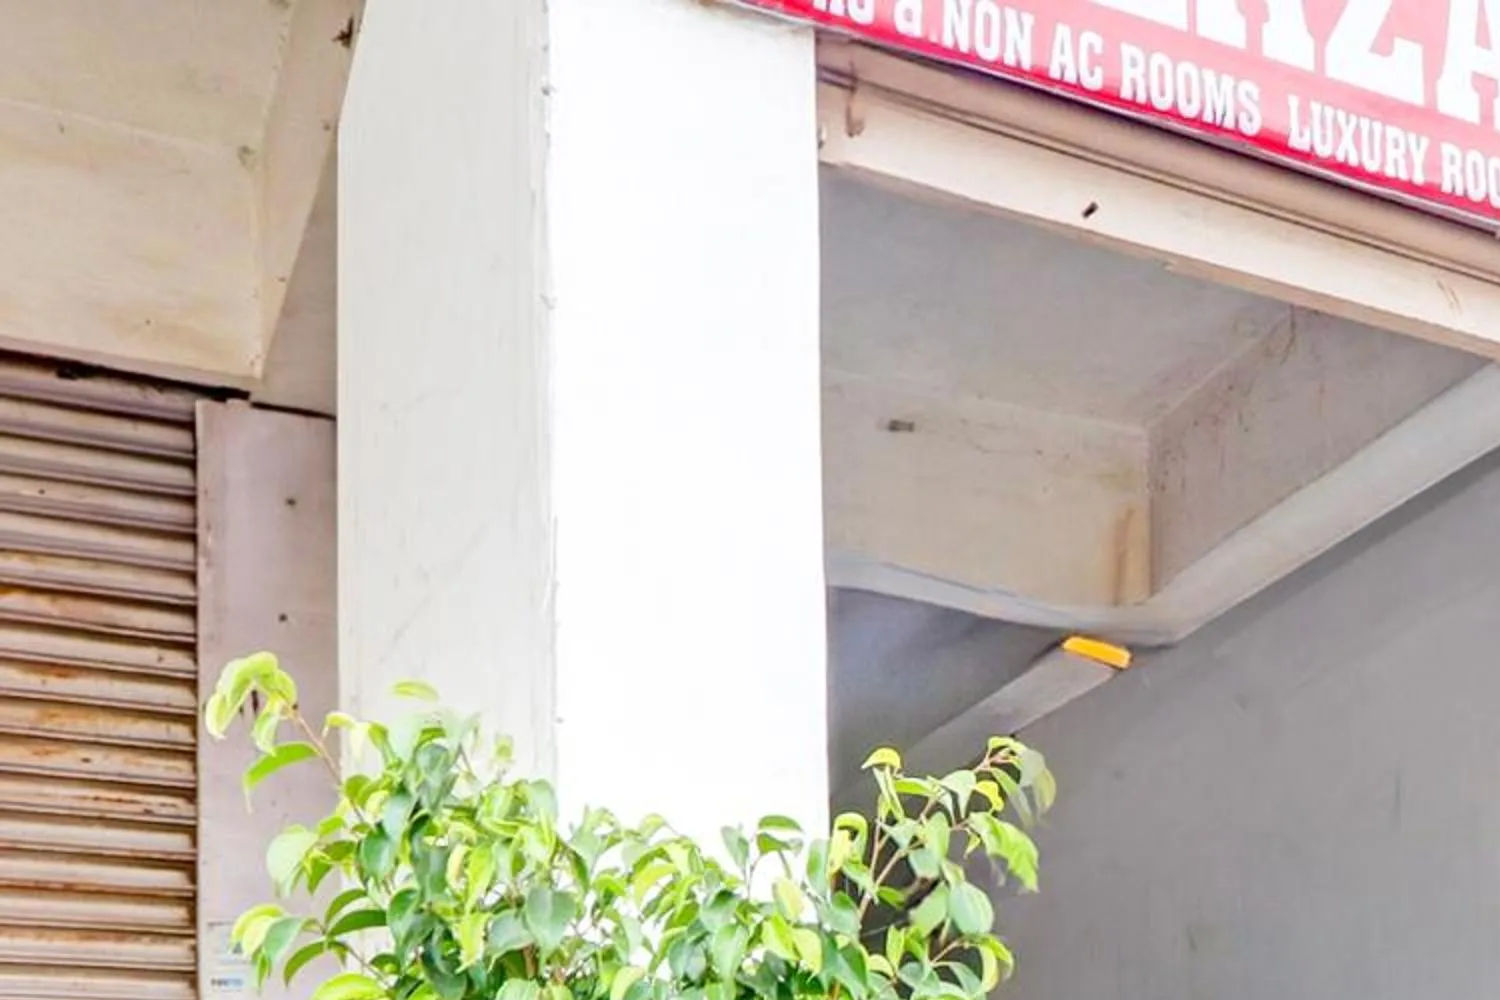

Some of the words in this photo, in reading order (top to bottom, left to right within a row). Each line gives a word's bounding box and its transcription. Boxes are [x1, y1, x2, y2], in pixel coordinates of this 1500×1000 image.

[942, 0, 1034, 71] NON
[1048, 22, 1104, 90] AC
[1118, 42, 1262, 137] ROOMS
[1287, 94, 1431, 185] LUXURY
